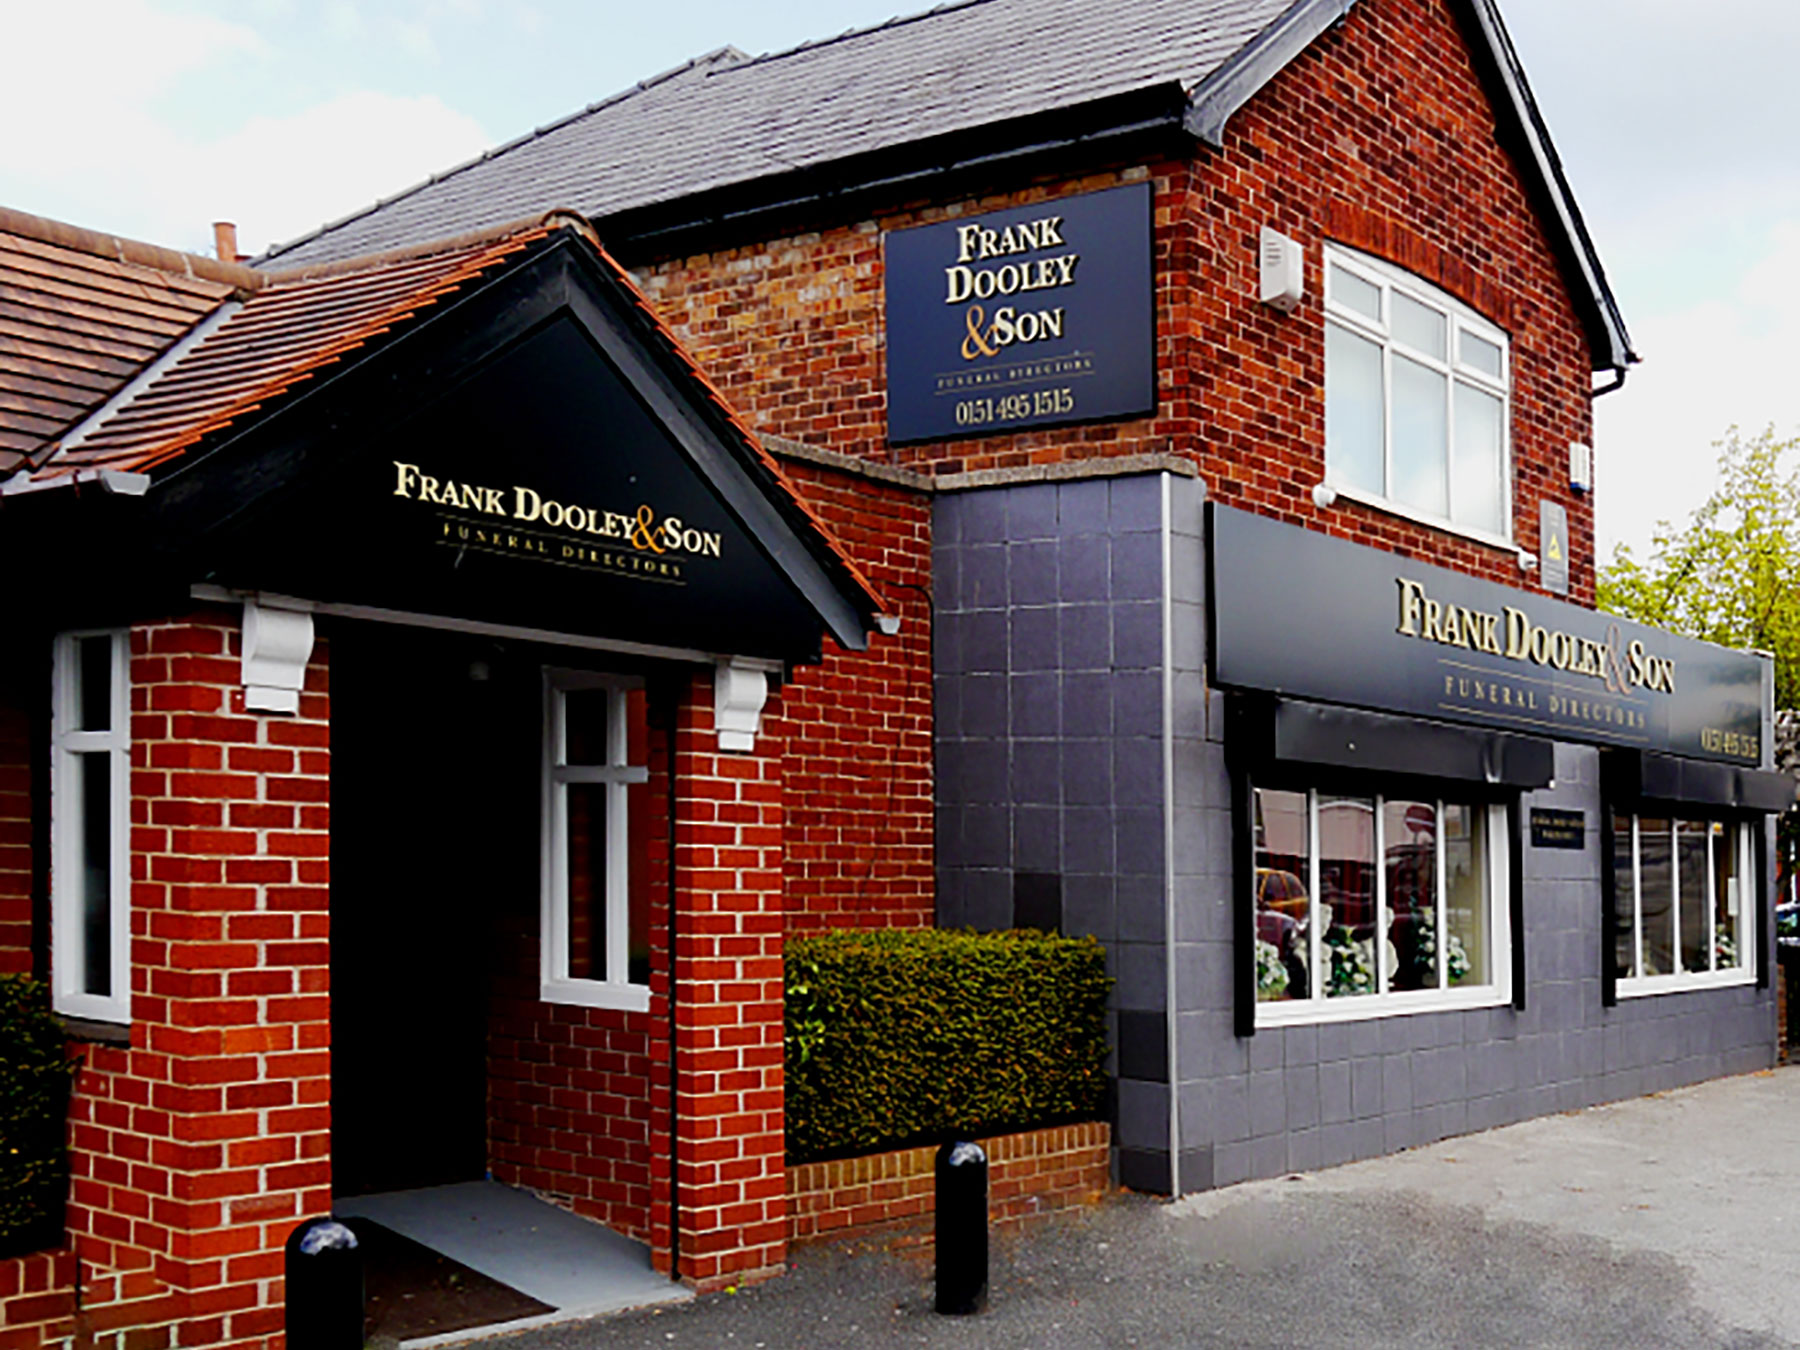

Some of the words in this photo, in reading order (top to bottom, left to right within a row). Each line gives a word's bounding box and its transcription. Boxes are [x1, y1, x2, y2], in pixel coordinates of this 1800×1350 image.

[957, 217, 1064, 263] FRANK
[945, 254, 1077, 303] DOOLEY
[956, 399, 993, 425] 0151
[996, 394, 1031, 419] 495
[1033, 388, 1073, 415] 1515
[393, 461, 507, 515] FRANK
[513, 486, 637, 539] DOOLEY
[443, 523, 549, 552] FUNERAL
[562, 545, 681, 577] DIRECTORS
[1396, 577, 1502, 654] FRANK
[1503, 606, 1609, 678] DOOLEY
[1445, 676, 1538, 710] FUNERAL
[1550, 694, 1646, 729] DIRECTORS
